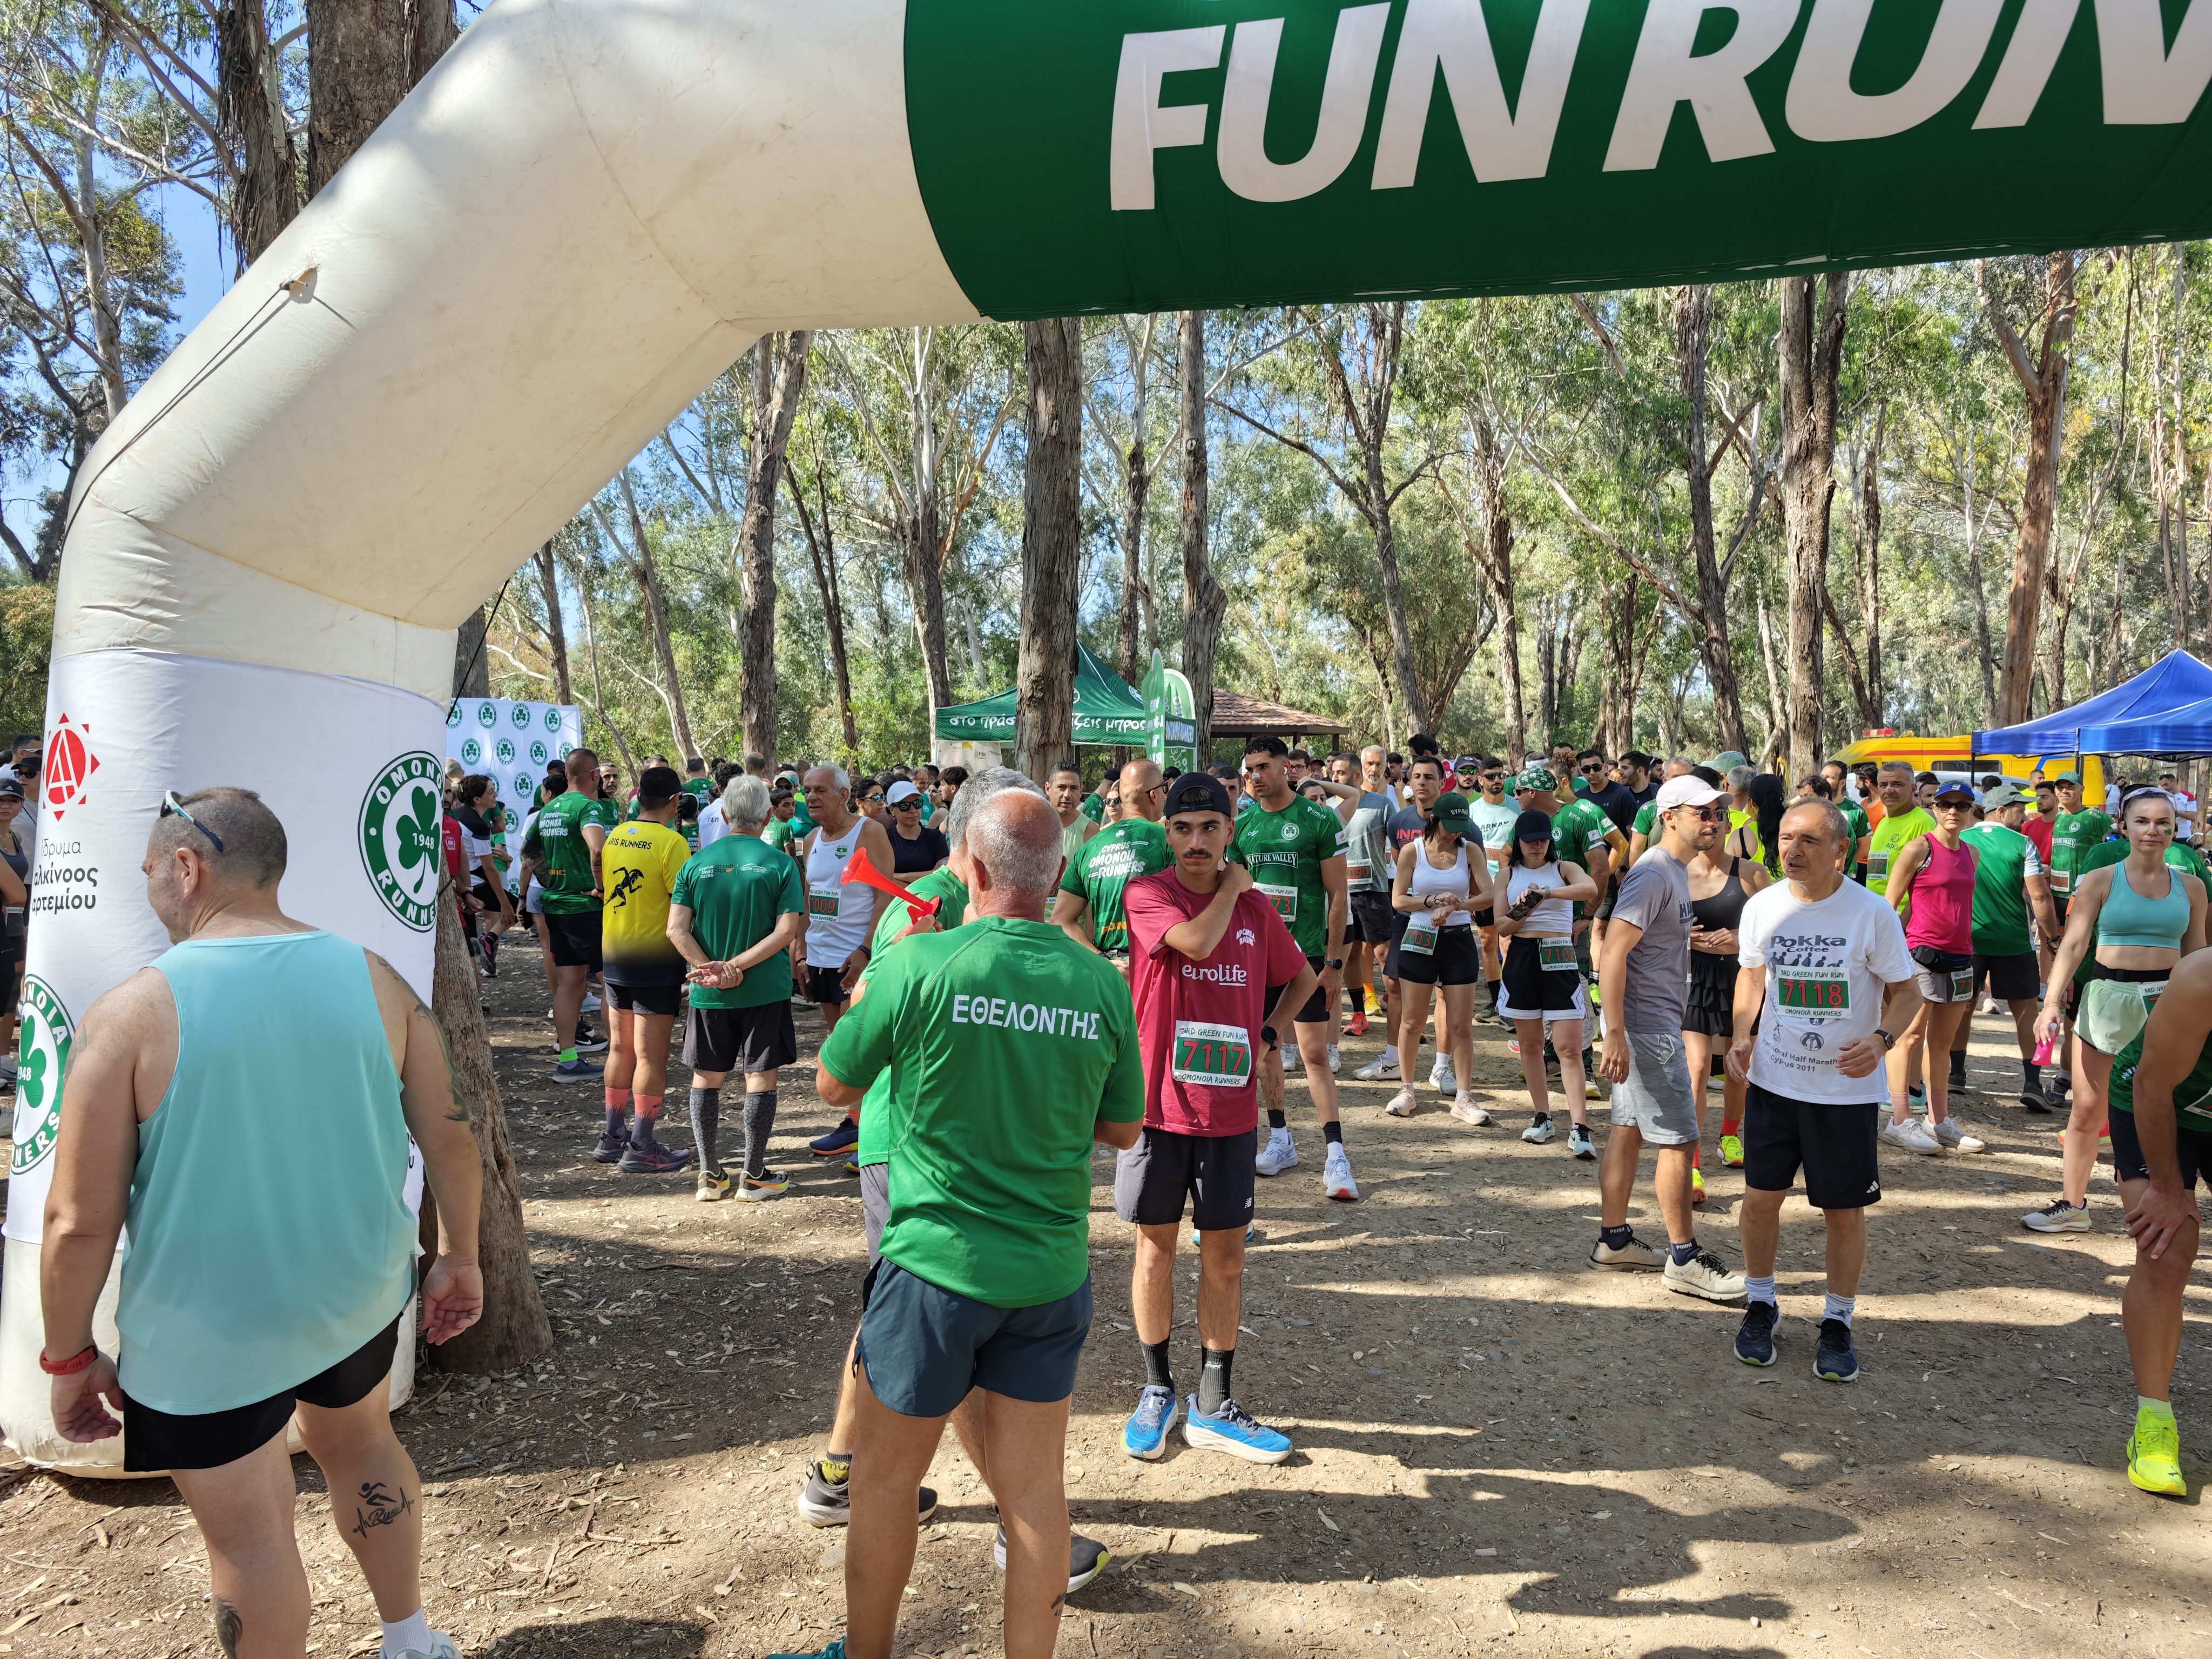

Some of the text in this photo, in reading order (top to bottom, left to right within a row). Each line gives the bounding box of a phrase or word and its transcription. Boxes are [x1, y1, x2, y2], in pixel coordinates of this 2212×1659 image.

[1110, 0, 2212, 211] FUN RUN
[949, 712, 1146, 733] στο πράσ ίζεις μπρος
[42, 838, 82, 859] ίδρυμα
[412, 832, 434, 849] 1948
[608, 838, 652, 850] ARIS RUNNERS
[1101, 840, 1131, 853] CYPRUS
[1089, 848, 1136, 868] OMONOIA
[1246, 853, 1297, 868] NATURE VALLEY
[1486, 848, 1499, 860] 70
[34, 862, 99, 887] αλκίνοος
[1348, 867, 1369, 879] 090
[32, 887, 96, 916] αρτεμίου
[1270, 896, 1291, 914] 73
[1239, 936, 1254, 947] RACING
[1770, 935, 1846, 949] Pokka
[1182, 964, 1247, 982] eurolife
[1783, 981, 1843, 1006] 7118
[1958, 978, 1972, 993] 71
[952, 994, 1100, 1040] ΕΘΕΛΟΝΤΗΣ
[1198, 1029, 1221, 1037] GREEN
[1222, 1031, 1234, 1039] FUN
[1182, 1040, 1245, 1073] 7117
[1790, 1053, 1806, 1062] Half
[1797, 1064, 1815, 1072] 2011
[1182, 1074, 1241, 1085] OMONOIA RUNNERS
